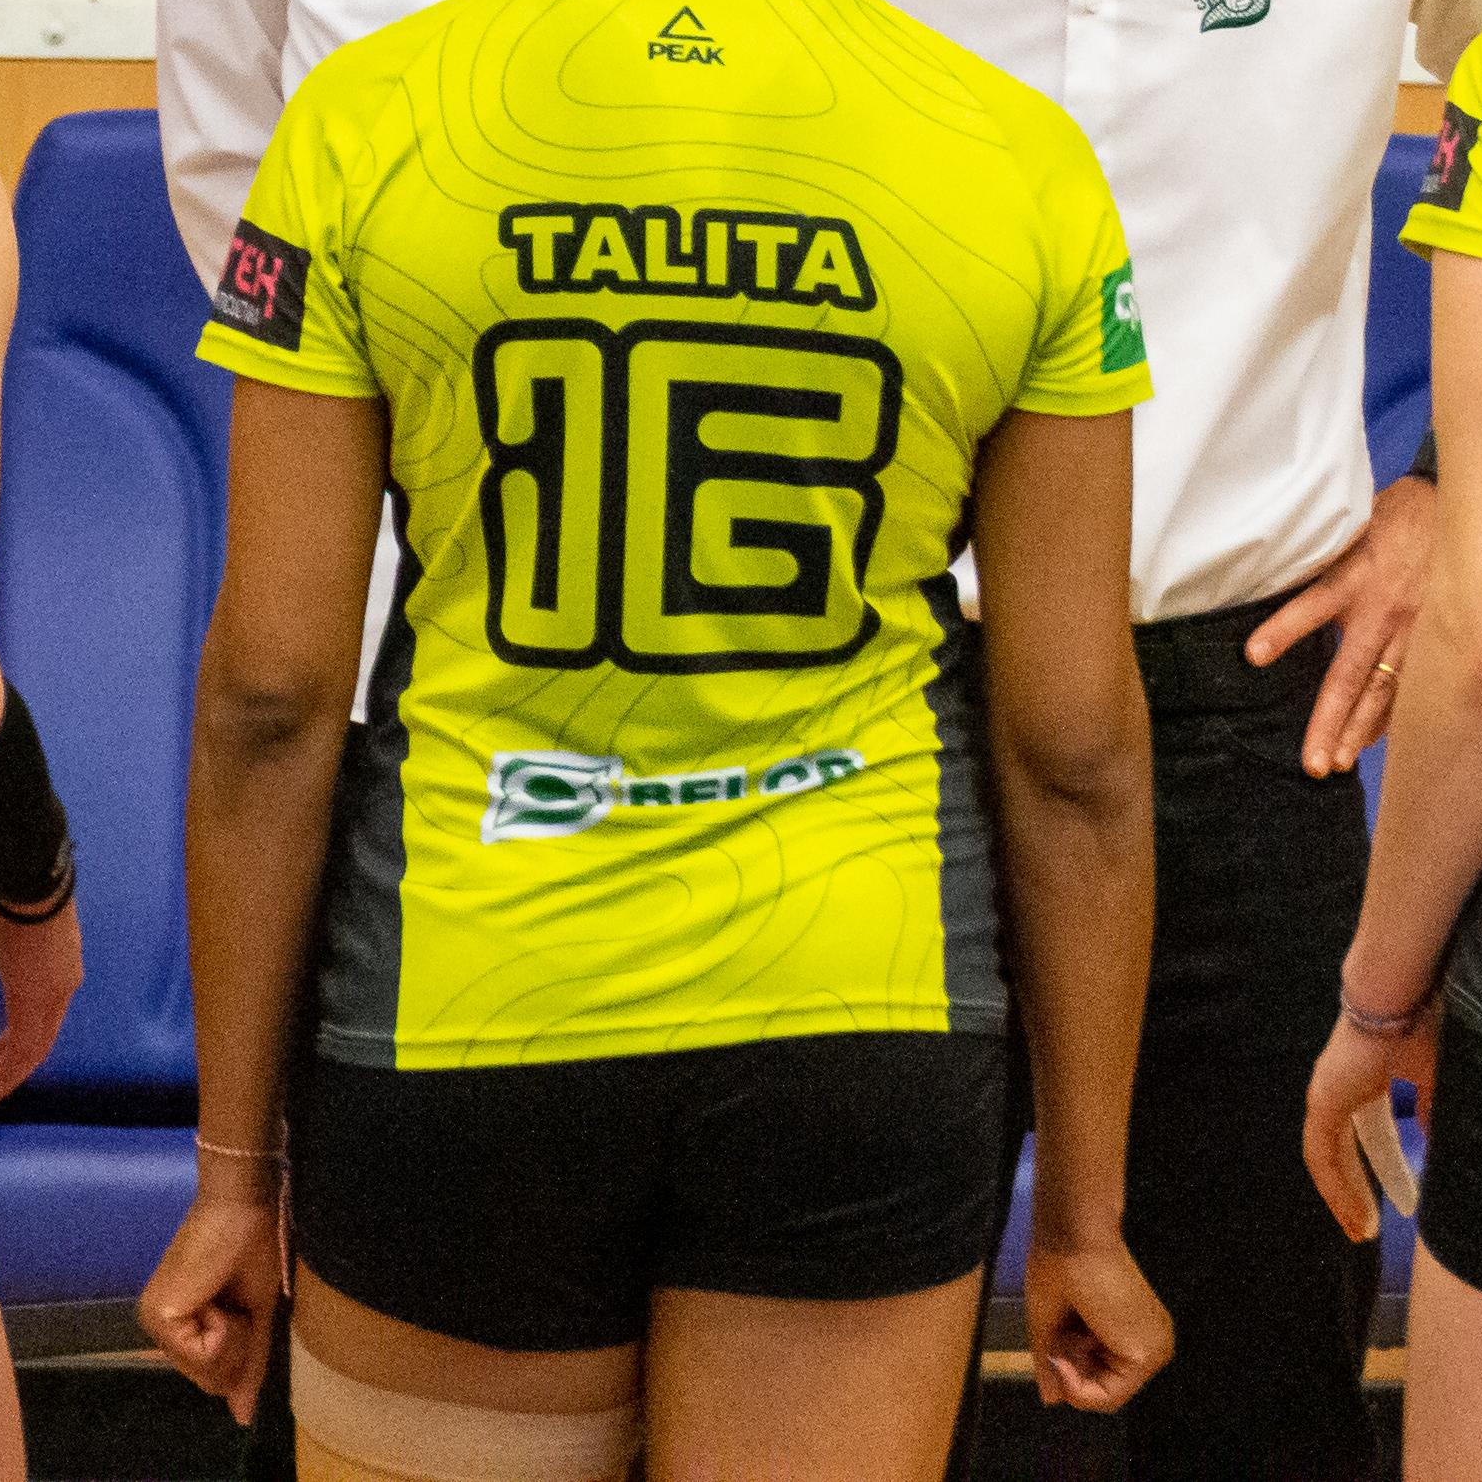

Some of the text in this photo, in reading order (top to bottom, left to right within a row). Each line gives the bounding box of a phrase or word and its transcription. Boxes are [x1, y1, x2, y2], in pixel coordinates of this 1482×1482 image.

[647, 41, 725, 67] PEAK
[499, 203, 877, 312] TALITA
[472, 318, 903, 675] 16
